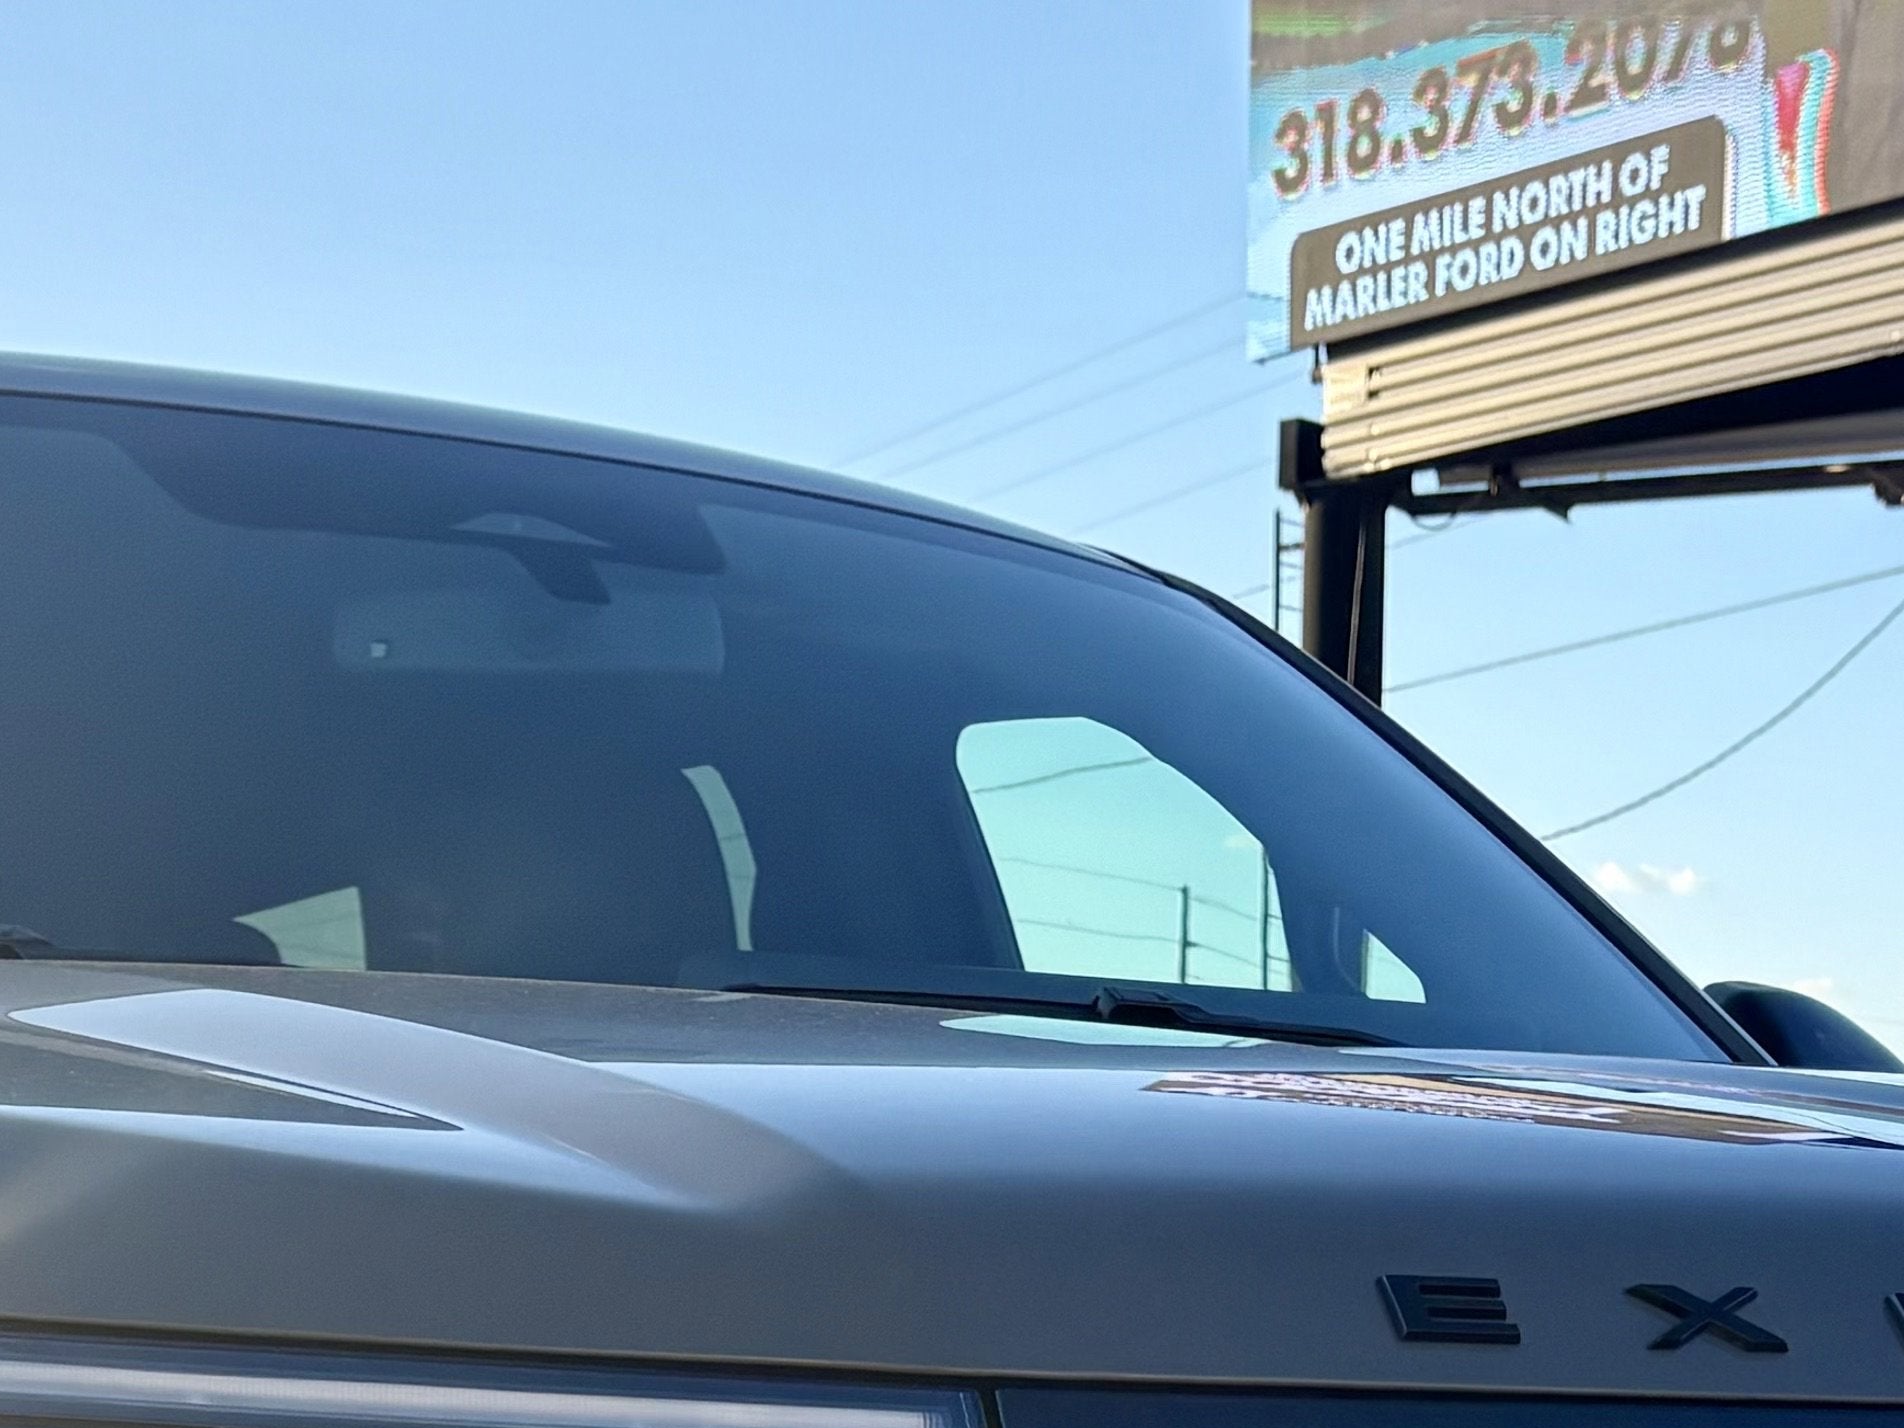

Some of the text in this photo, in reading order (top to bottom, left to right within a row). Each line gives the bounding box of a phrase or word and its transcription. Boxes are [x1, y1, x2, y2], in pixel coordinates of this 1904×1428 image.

[1304, 184, 1706, 331] MARLER FORD ON RIGHT
[1335, 144, 1670, 275] ONE MILE NORTH OF
